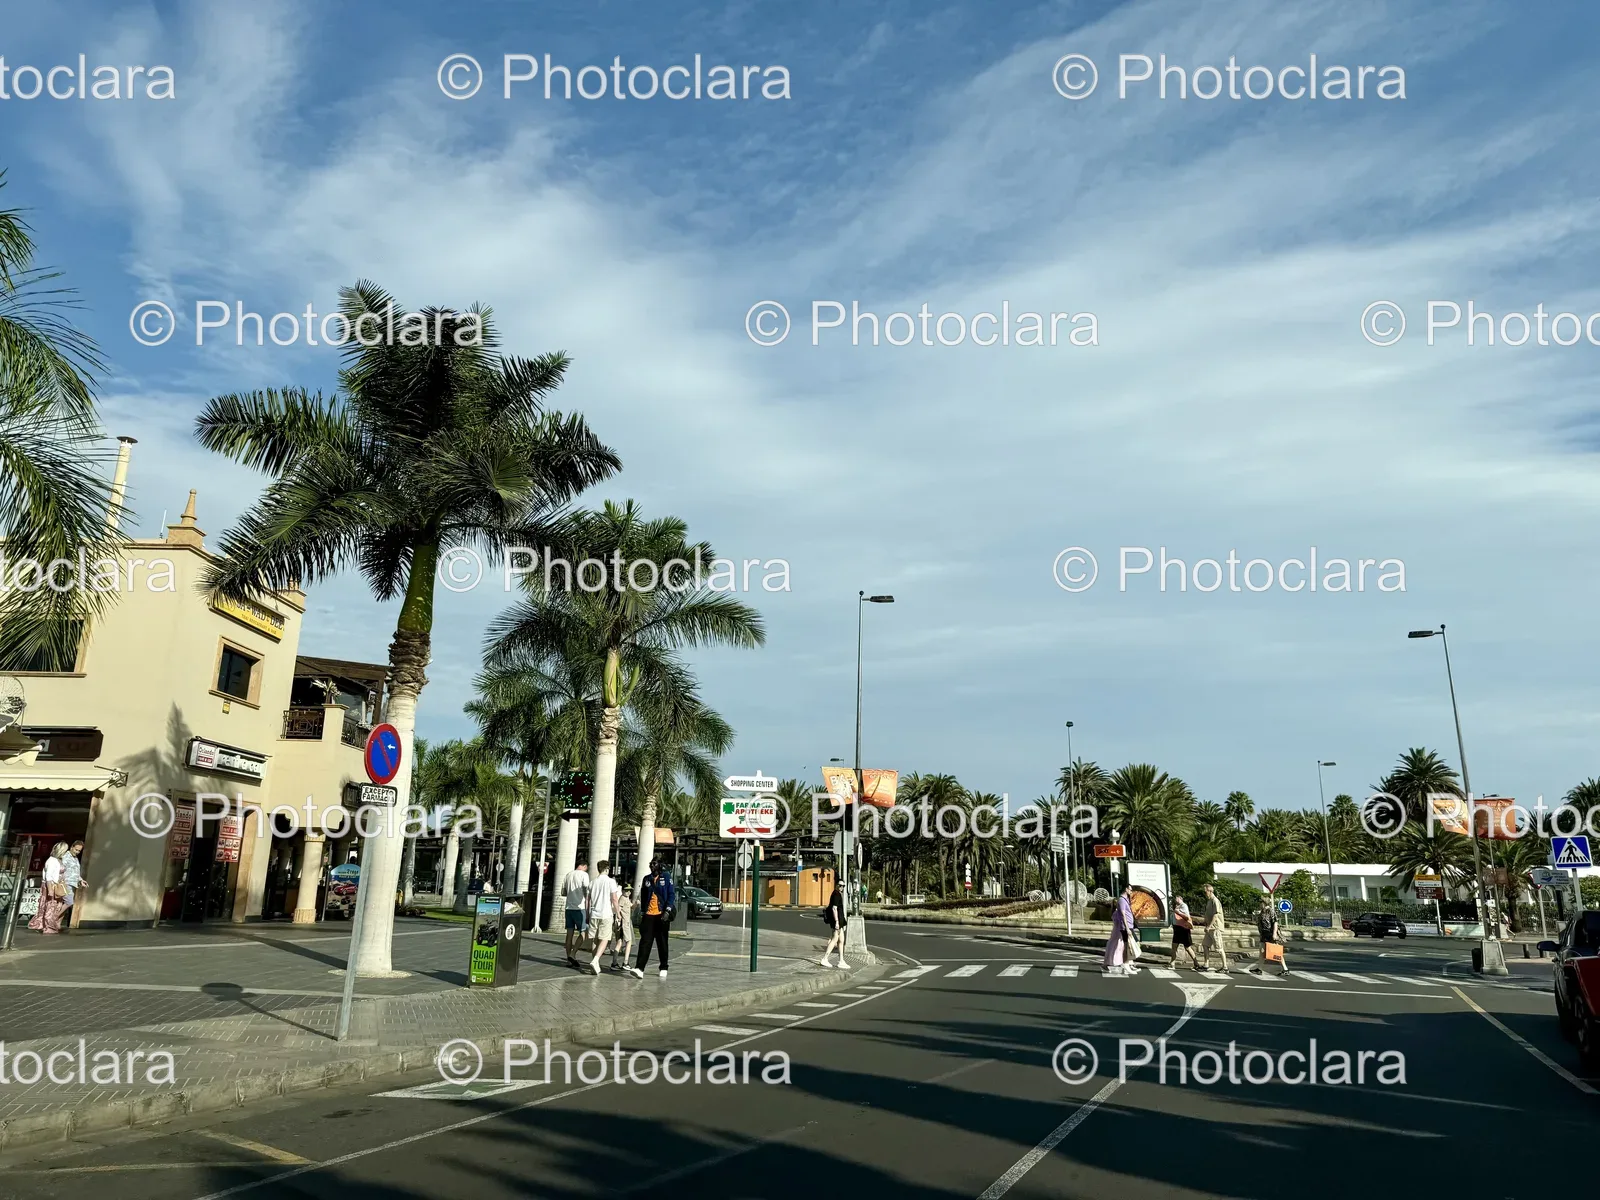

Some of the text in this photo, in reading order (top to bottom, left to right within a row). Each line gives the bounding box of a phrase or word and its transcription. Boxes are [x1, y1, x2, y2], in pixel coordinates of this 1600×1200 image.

[364, 786, 394, 796] EXCEPTO
[362, 793, 395, 802] FARMACIA
[473, 950, 495, 960] QUAD
[473, 960, 493, 970] TOUR
